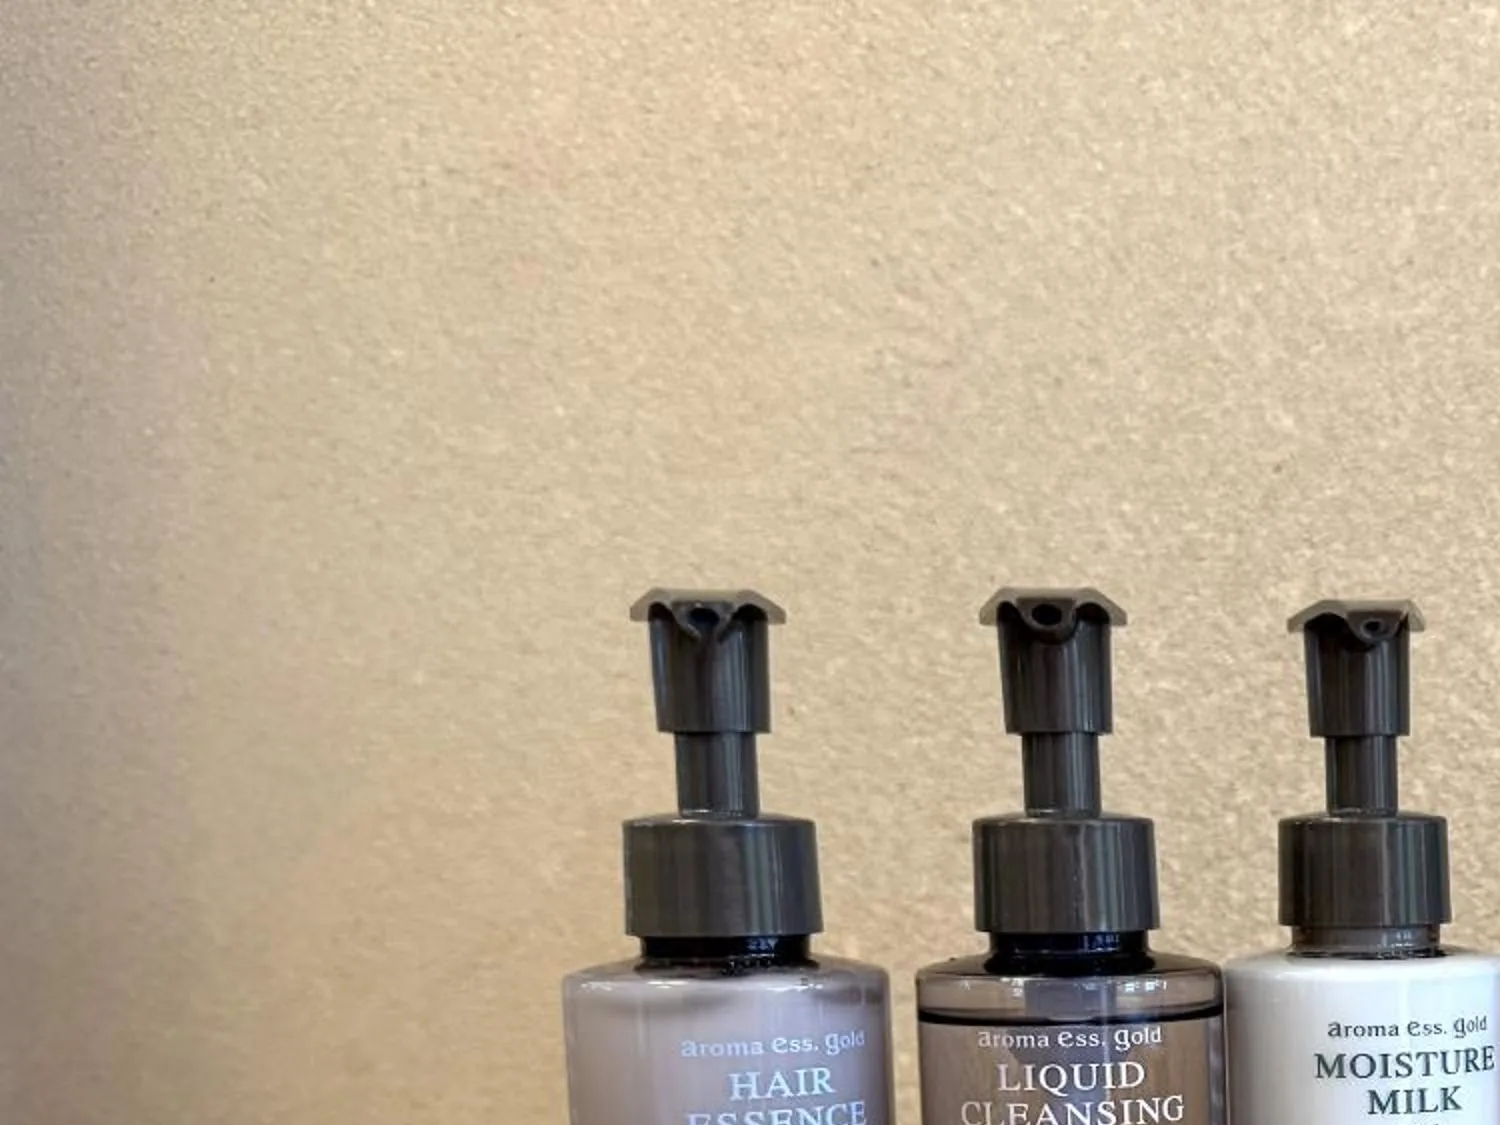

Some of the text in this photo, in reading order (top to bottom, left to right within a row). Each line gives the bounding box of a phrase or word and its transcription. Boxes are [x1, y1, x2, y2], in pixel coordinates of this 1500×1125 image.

[978, 1026, 1163, 1051] aroma ess. gold
[1327, 1015, 1488, 1039] aroma ess. gold
[681, 1031, 865, 1058] aroma ess. gold
[1314, 1045, 1496, 1079] MOISTURE
[728, 1067, 837, 1101] HAIR
[997, 1061, 1146, 1097] LIQUID
[1367, 1085, 1463, 1115] MILK
